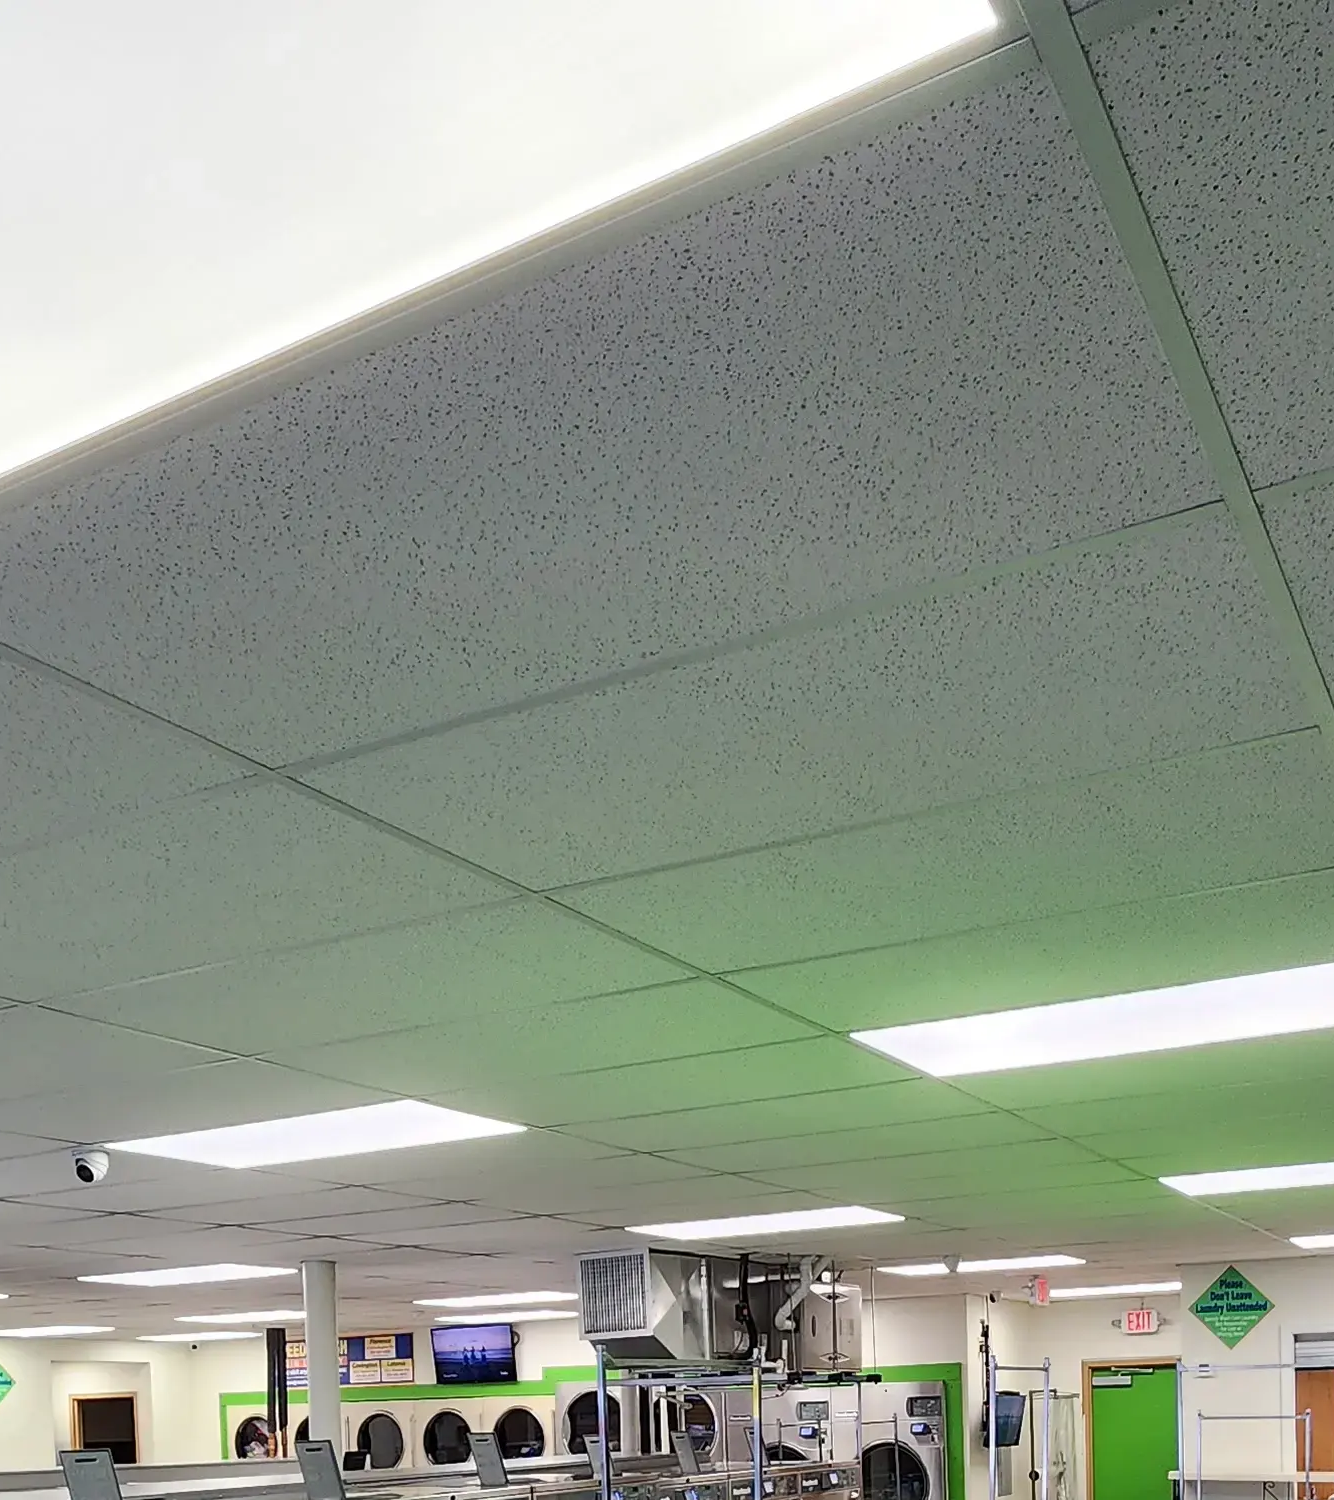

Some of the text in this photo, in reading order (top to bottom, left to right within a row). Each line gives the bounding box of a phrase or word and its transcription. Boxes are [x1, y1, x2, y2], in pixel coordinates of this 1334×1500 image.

[1219, 1279, 1244, 1289] Please
[1210, 1290, 1252, 1300] Don't Leave
[1196, 1301, 1267, 1315] Laundry Unattended
[1127, 1311, 1152, 1331] EXIT
